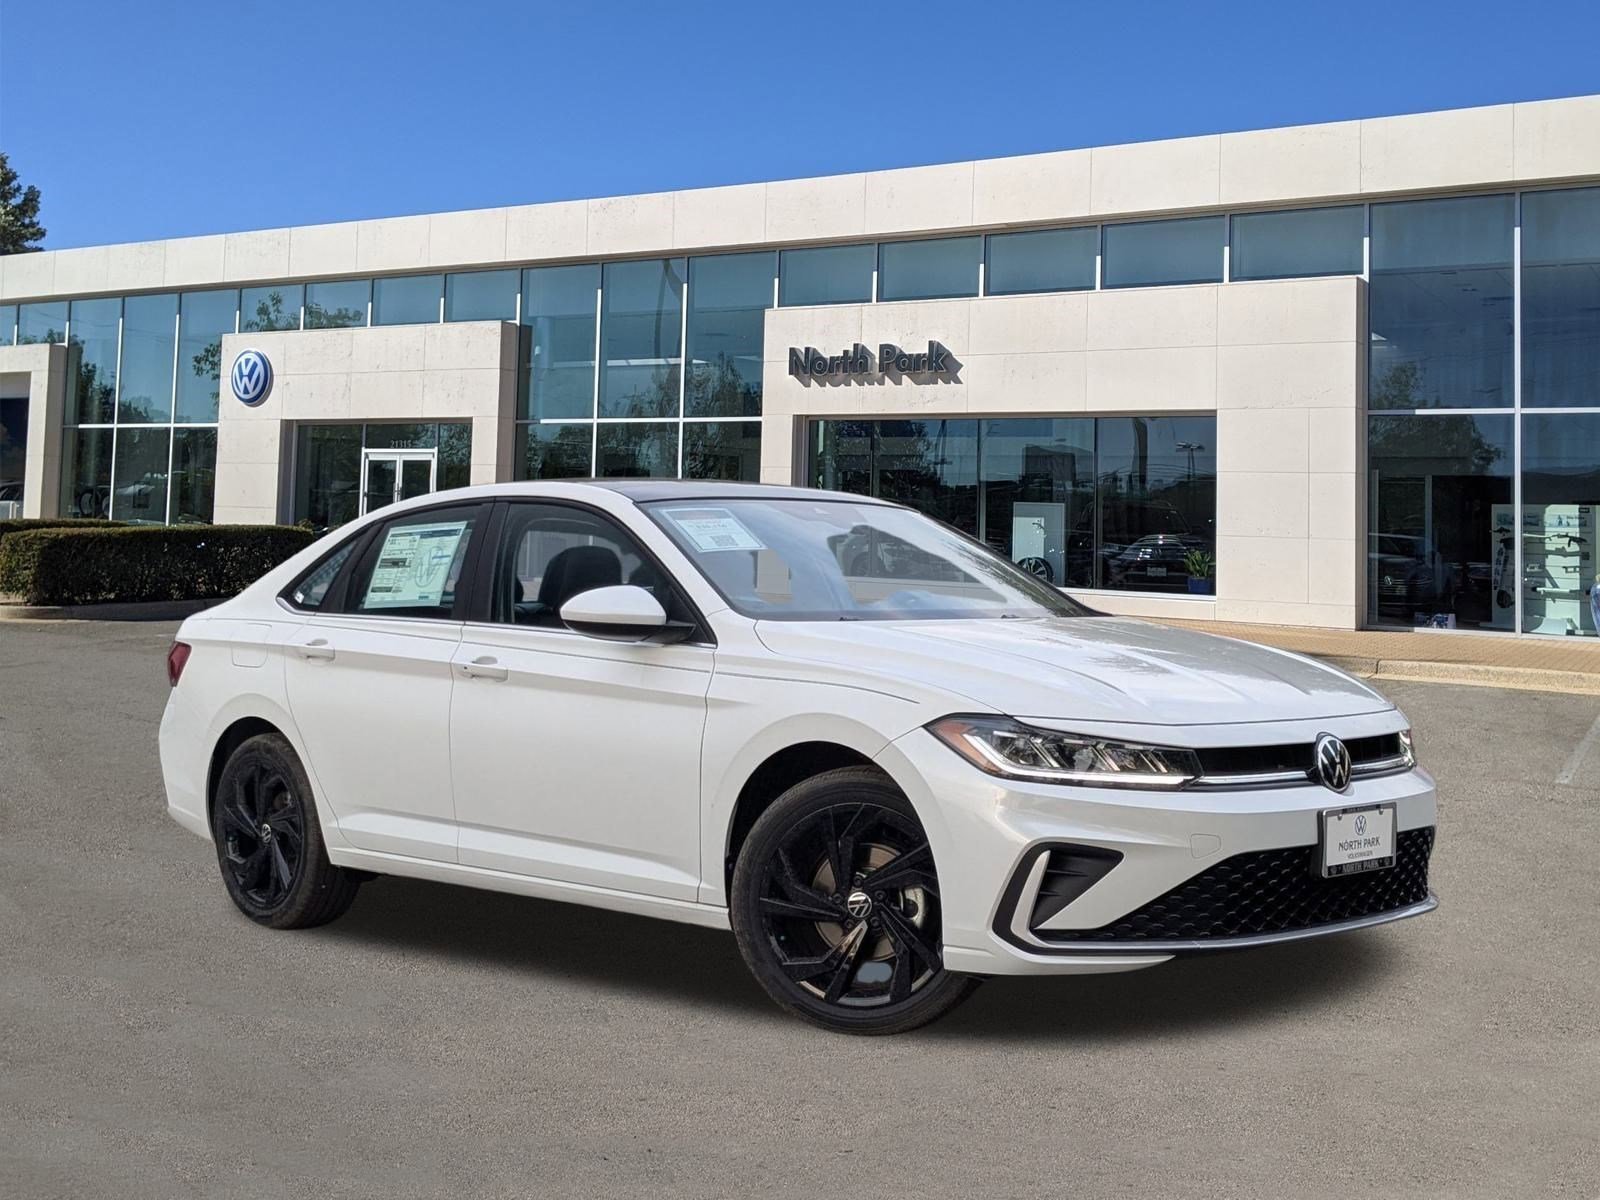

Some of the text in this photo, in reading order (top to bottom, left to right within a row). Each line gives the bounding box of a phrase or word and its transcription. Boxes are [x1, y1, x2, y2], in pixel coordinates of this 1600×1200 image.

[788, 340, 948, 377] North Park
[390, 440, 412, 449] 21315
[1338, 836, 1381, 852] NORTH PARK
[1342, 859, 1380, 873] NORTH PARK
